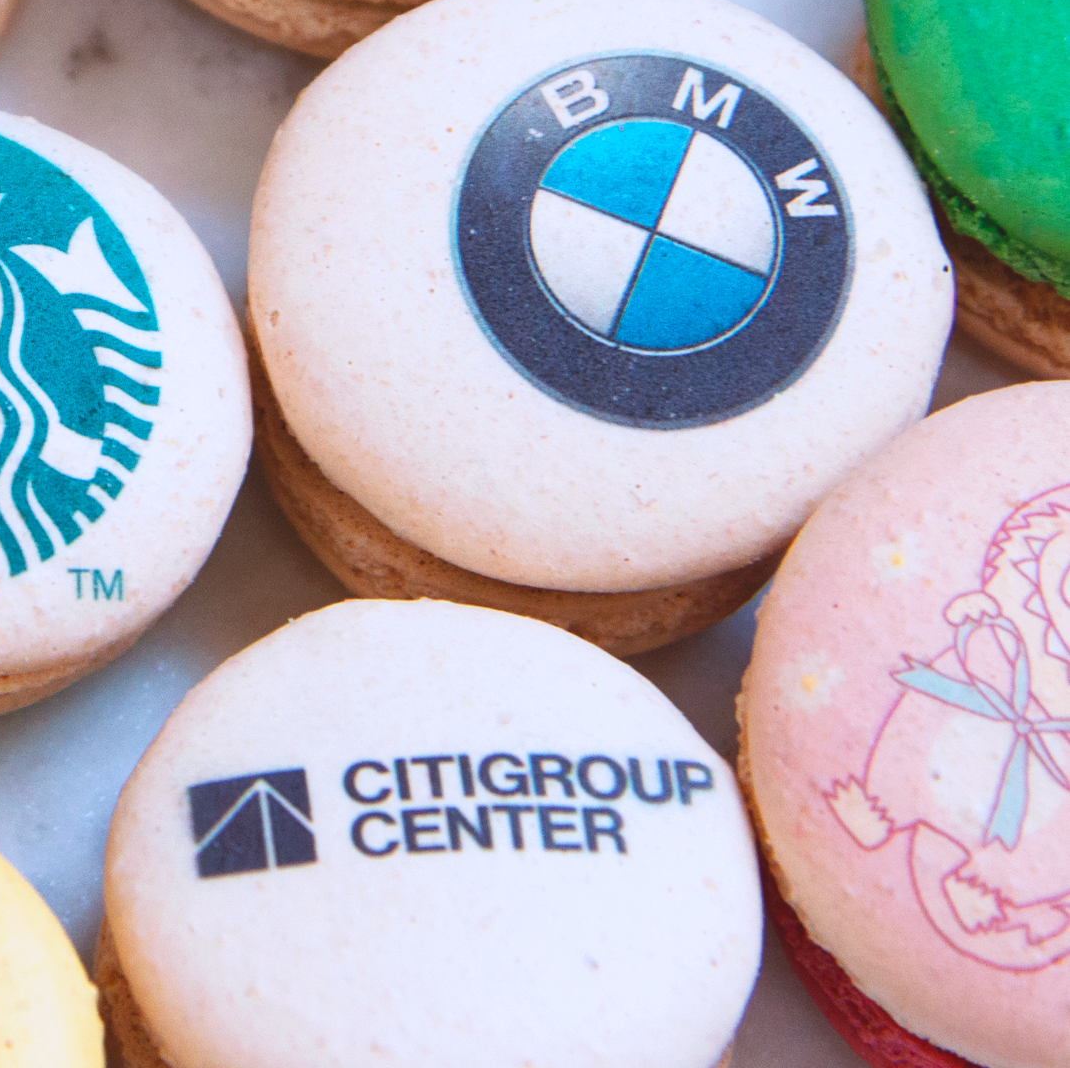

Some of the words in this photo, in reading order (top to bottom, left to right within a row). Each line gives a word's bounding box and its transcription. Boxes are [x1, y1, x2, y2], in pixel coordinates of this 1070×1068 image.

[540, 67, 838, 220] BMW
[68, 568, 124, 602] TM
[342, 752, 714, 806] CITIGROUP
[349, 804, 628, 857] CENTER
